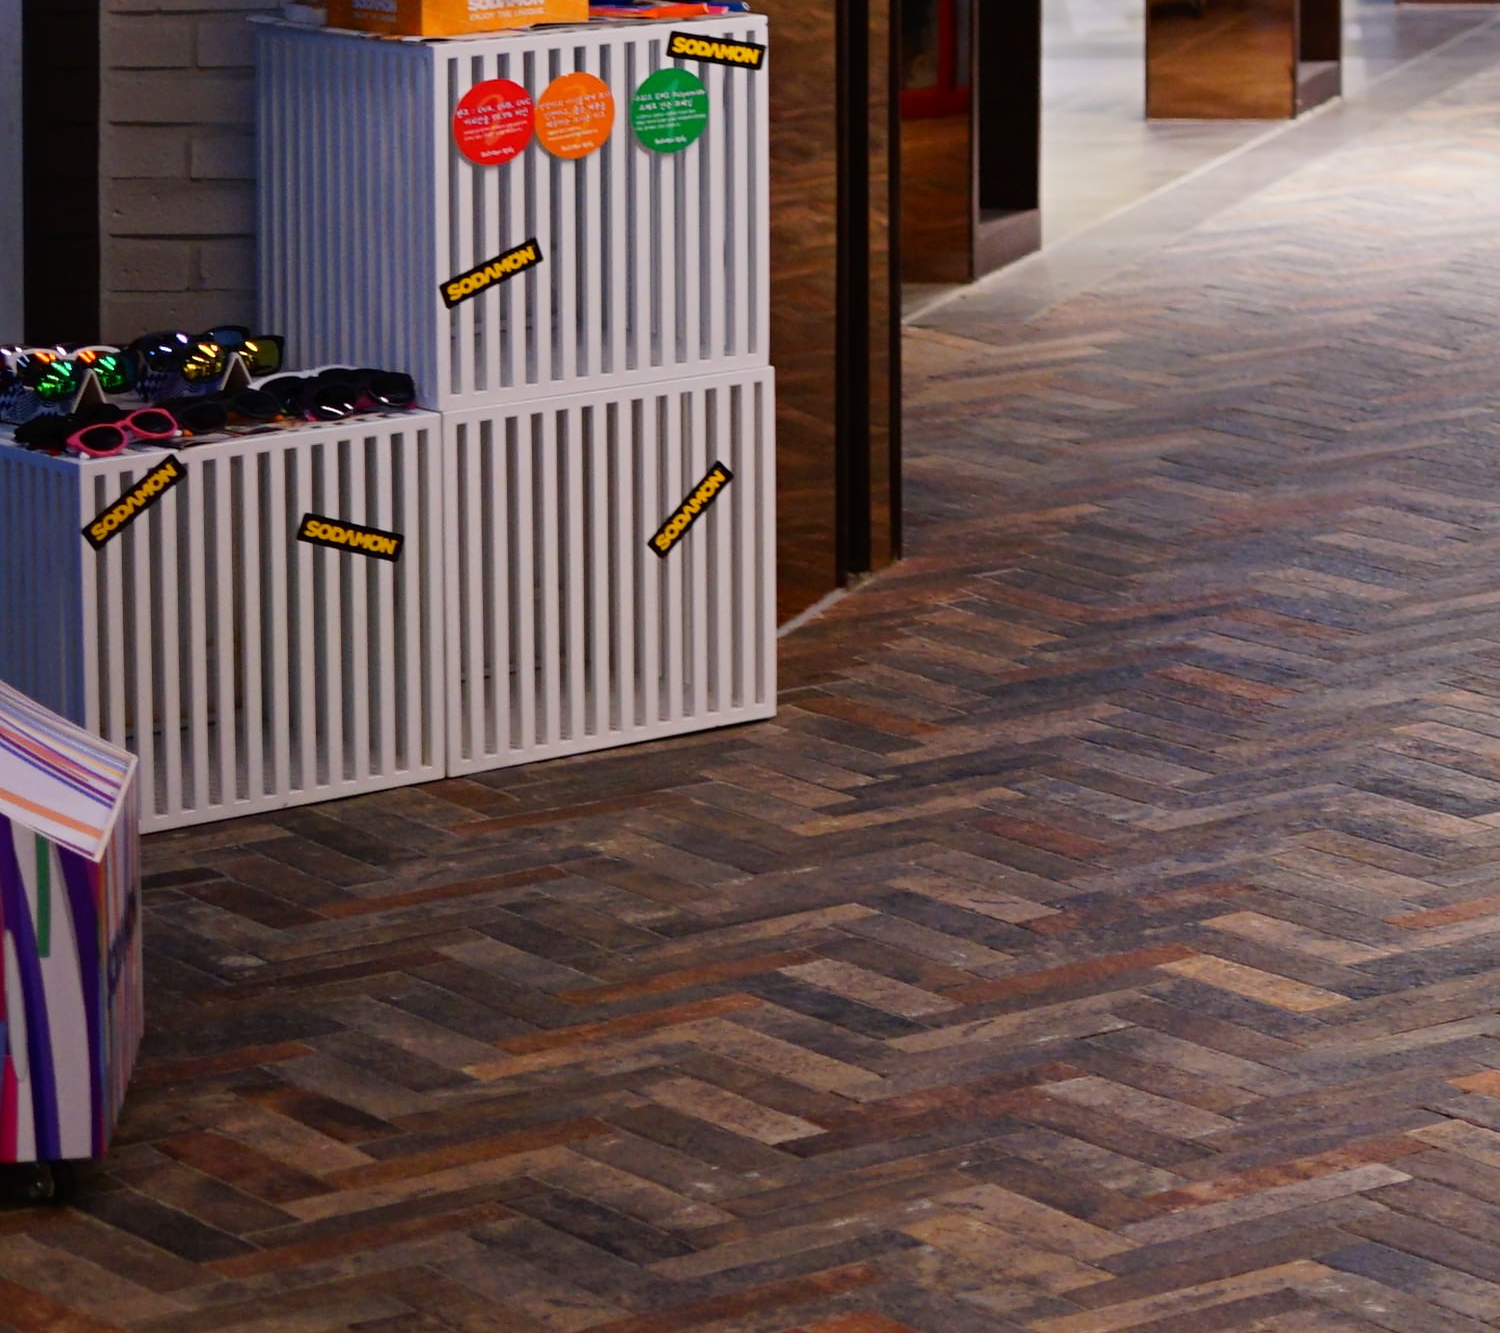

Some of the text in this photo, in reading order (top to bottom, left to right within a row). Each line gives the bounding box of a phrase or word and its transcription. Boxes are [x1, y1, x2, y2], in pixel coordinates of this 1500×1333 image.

[671, 36, 761, 65] SODAMON
[447, 245, 536, 301] SODAMON
[91, 463, 177, 541] SODAMON
[655, 469, 726, 551] SODAMON
[304, 520, 397, 555] SODAMON
